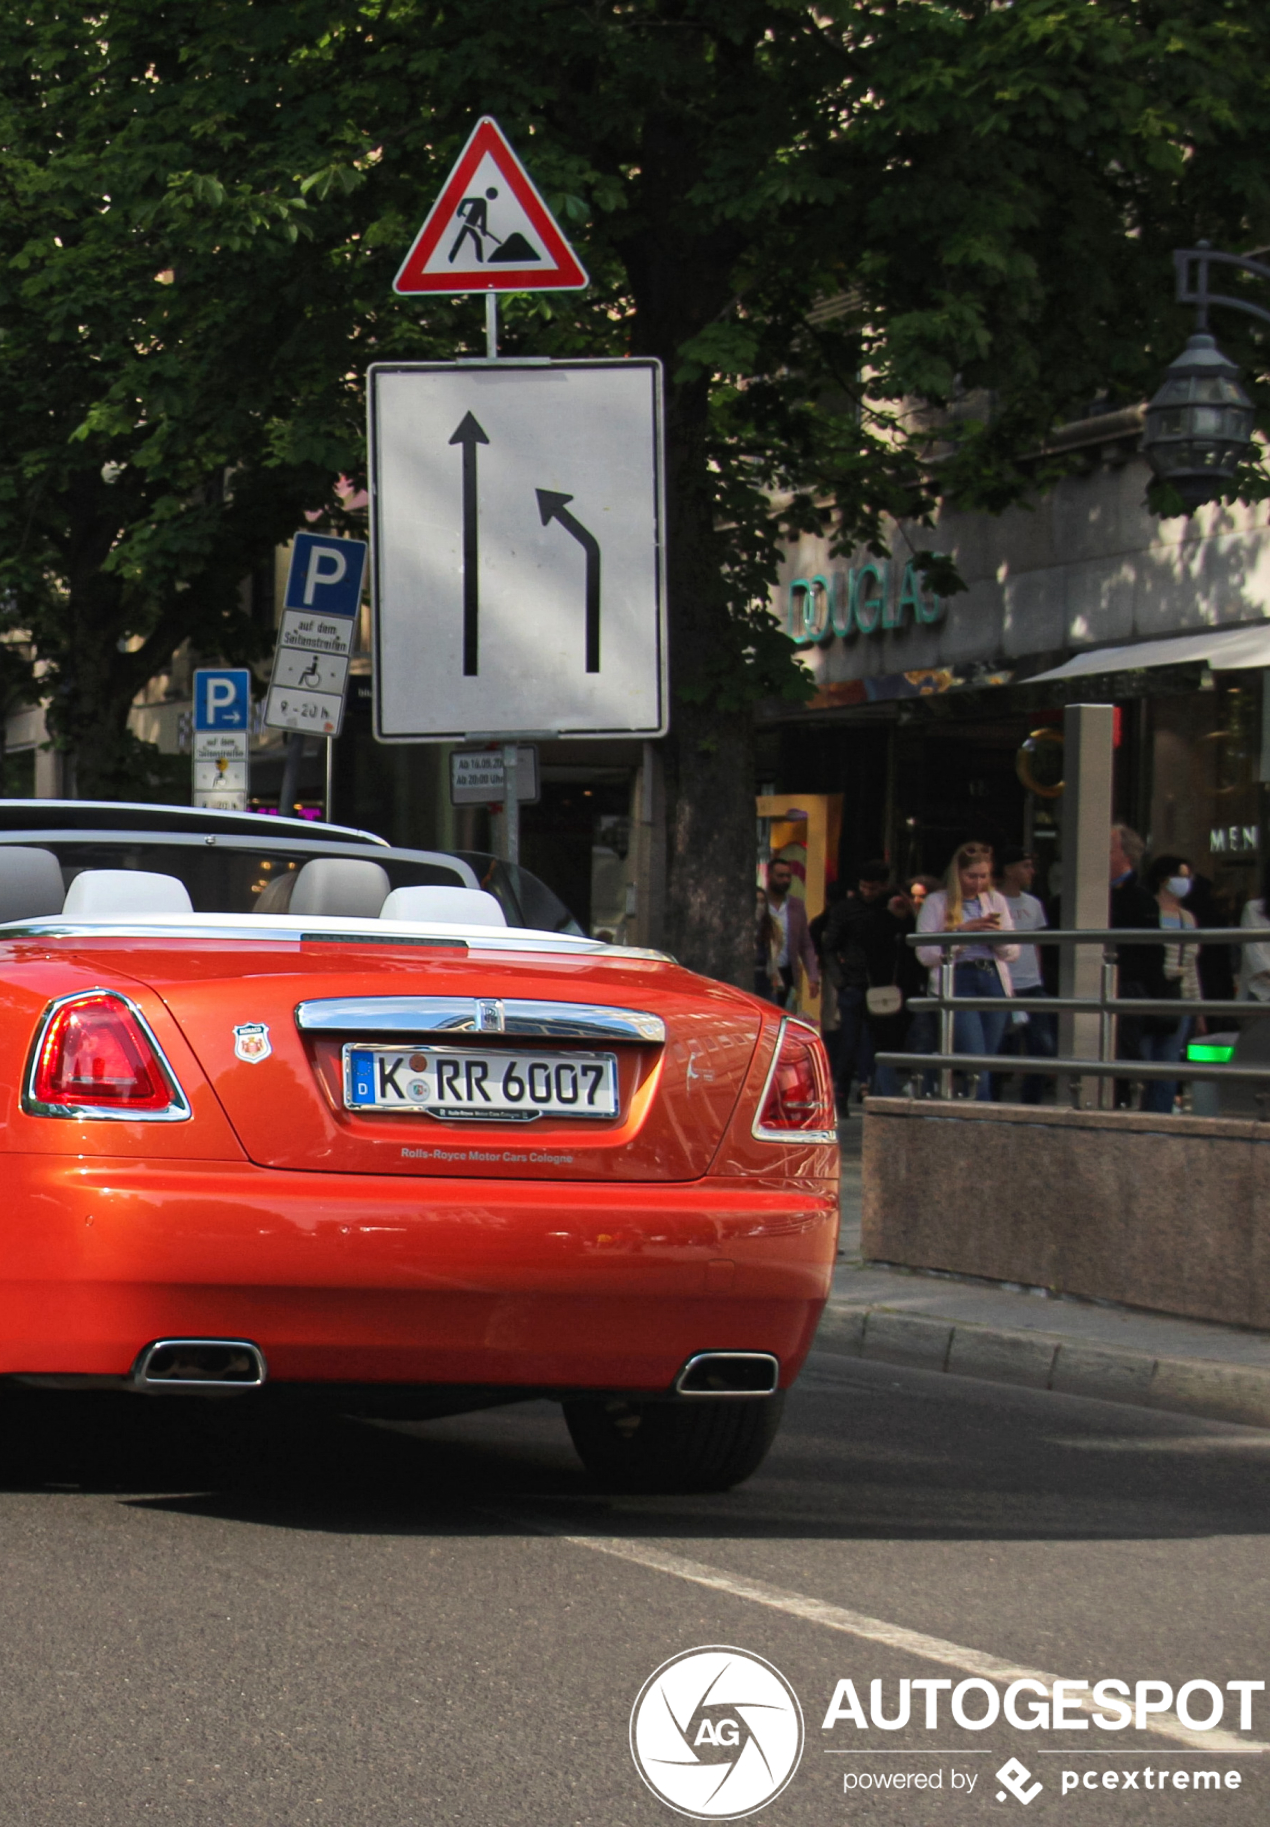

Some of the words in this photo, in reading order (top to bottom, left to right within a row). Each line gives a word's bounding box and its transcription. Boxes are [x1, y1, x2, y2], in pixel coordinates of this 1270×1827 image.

[303, 545, 347, 606] P
[298, 621, 314, 632] auf
[317, 622, 337, 635] dem
[284, 631, 347, 652] Seitenstreifen
[206, 678, 237, 725] P
[456, 775, 467, 785] Ab
[1210, 826, 1259, 852] MEN
[358, 1082, 368, 1096] D
[378, 1057, 405, 1099] K
[436, 1059, 492, 1102] RR
[502, 1061, 604, 1105] 6007
[401, 1147, 466, 1161] Rolls-Royce
[469, 1150, 500, 1162] Motor
[502, 1151, 528, 1163] Cars
[529, 1152, 573, 1165] Cologne
